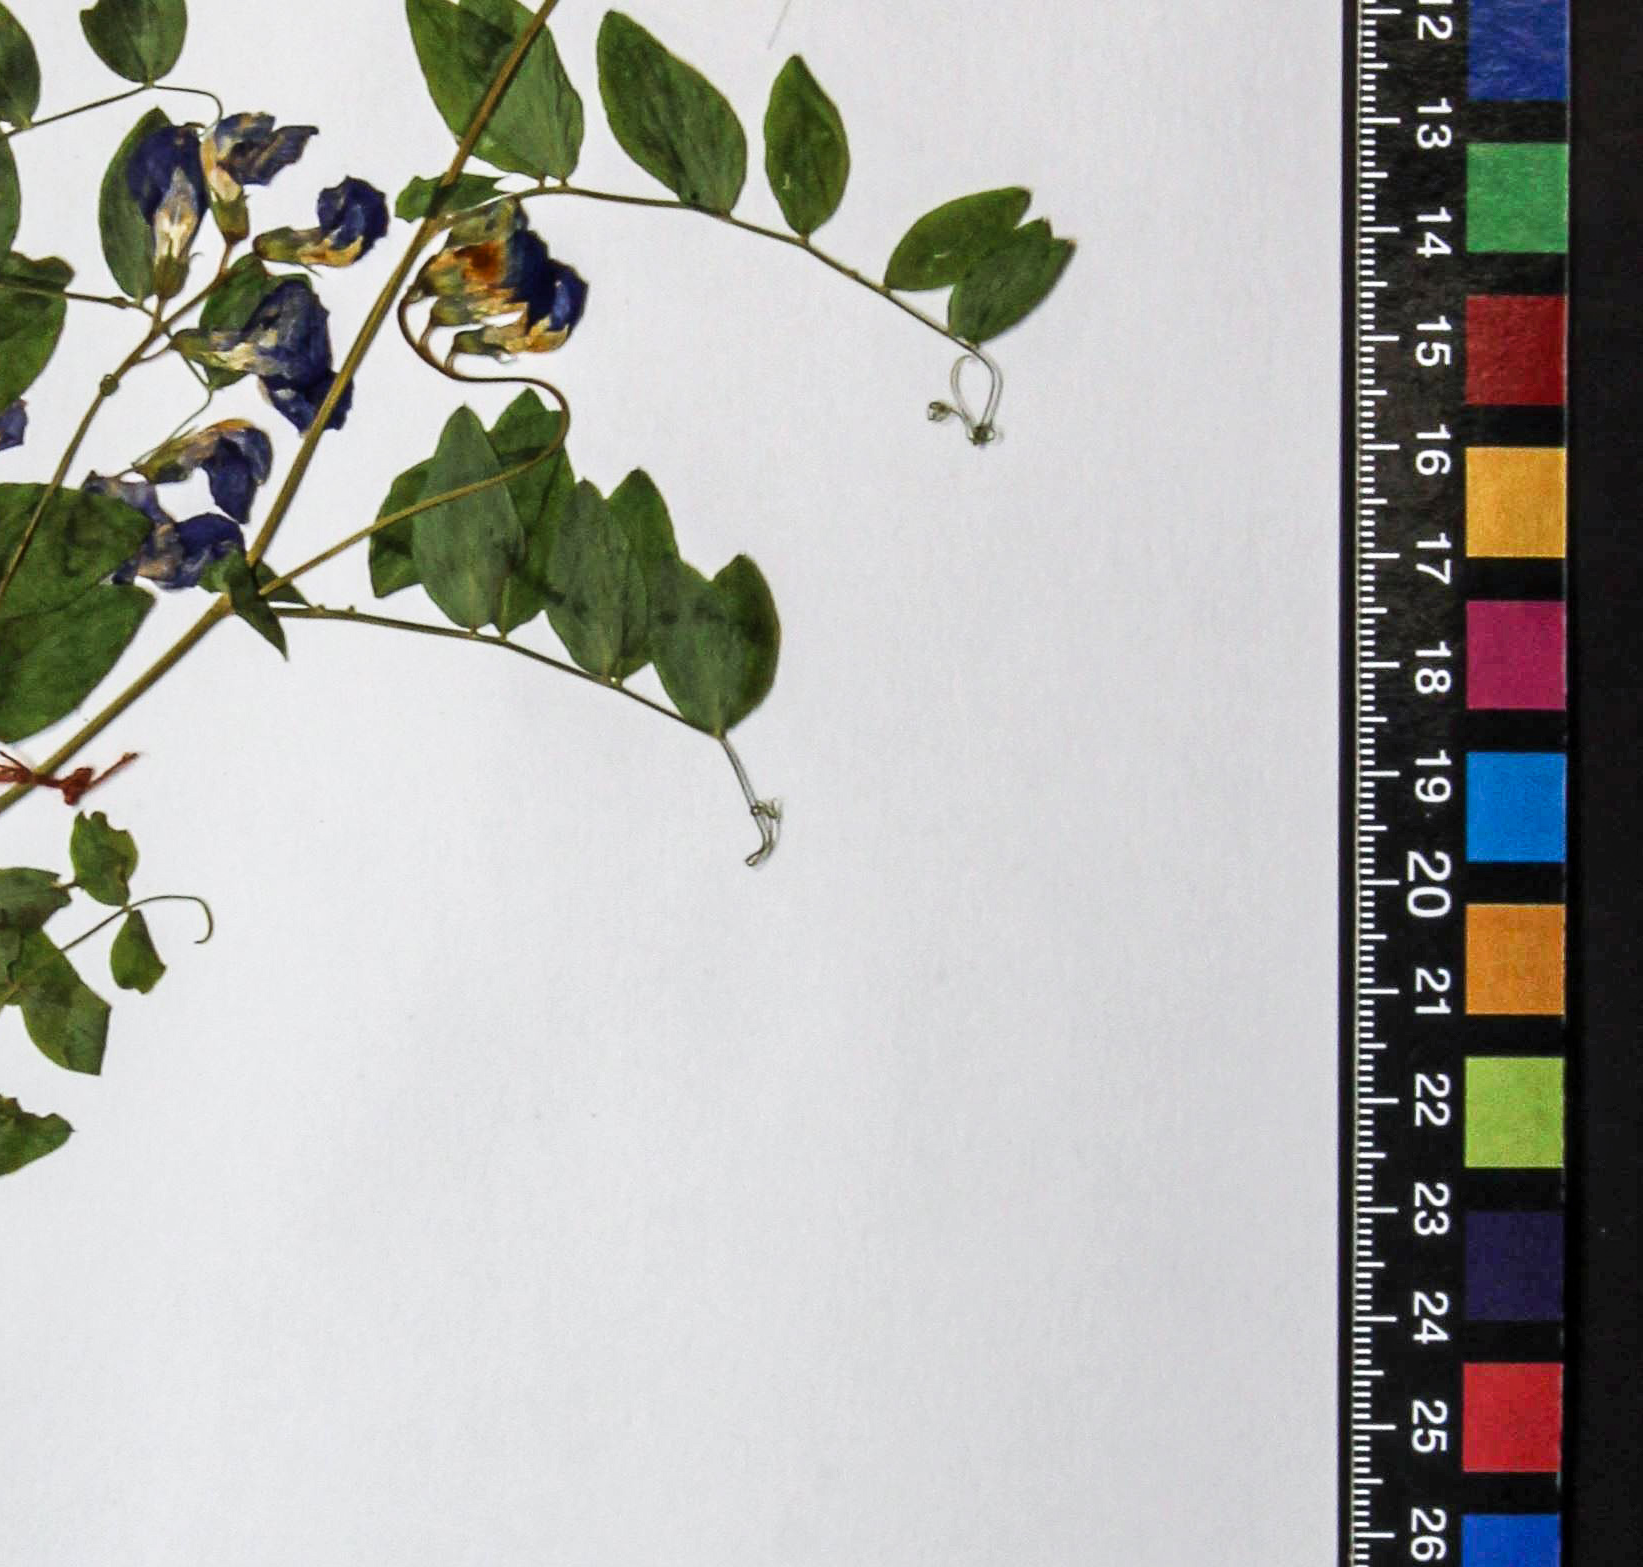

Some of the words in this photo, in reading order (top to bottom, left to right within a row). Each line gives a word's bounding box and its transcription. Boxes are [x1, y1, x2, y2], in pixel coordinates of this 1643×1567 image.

[1416, 97, 1453, 150] 13
[1416, 206, 1453, 259] 14
[1414, 314, 1453, 367] 15
[1415, 423, 1452, 476] 16
[1415, 532, 1452, 585] 17
[1414, 640, 1452, 695] 18
[1414, 749, 1452, 803] 19
[1406, 850, 1452, 918] 20
[1414, 967, 1452, 1014] 21
[1414, 1073, 1451, 1127] 22
[1413, 1182, 1451, 1236] 23
[1412, 1291, 1449, 1345] 24
[1411, 1399, 1448, 1453] 25
[1410, 1507, 1447, 1562] 26
